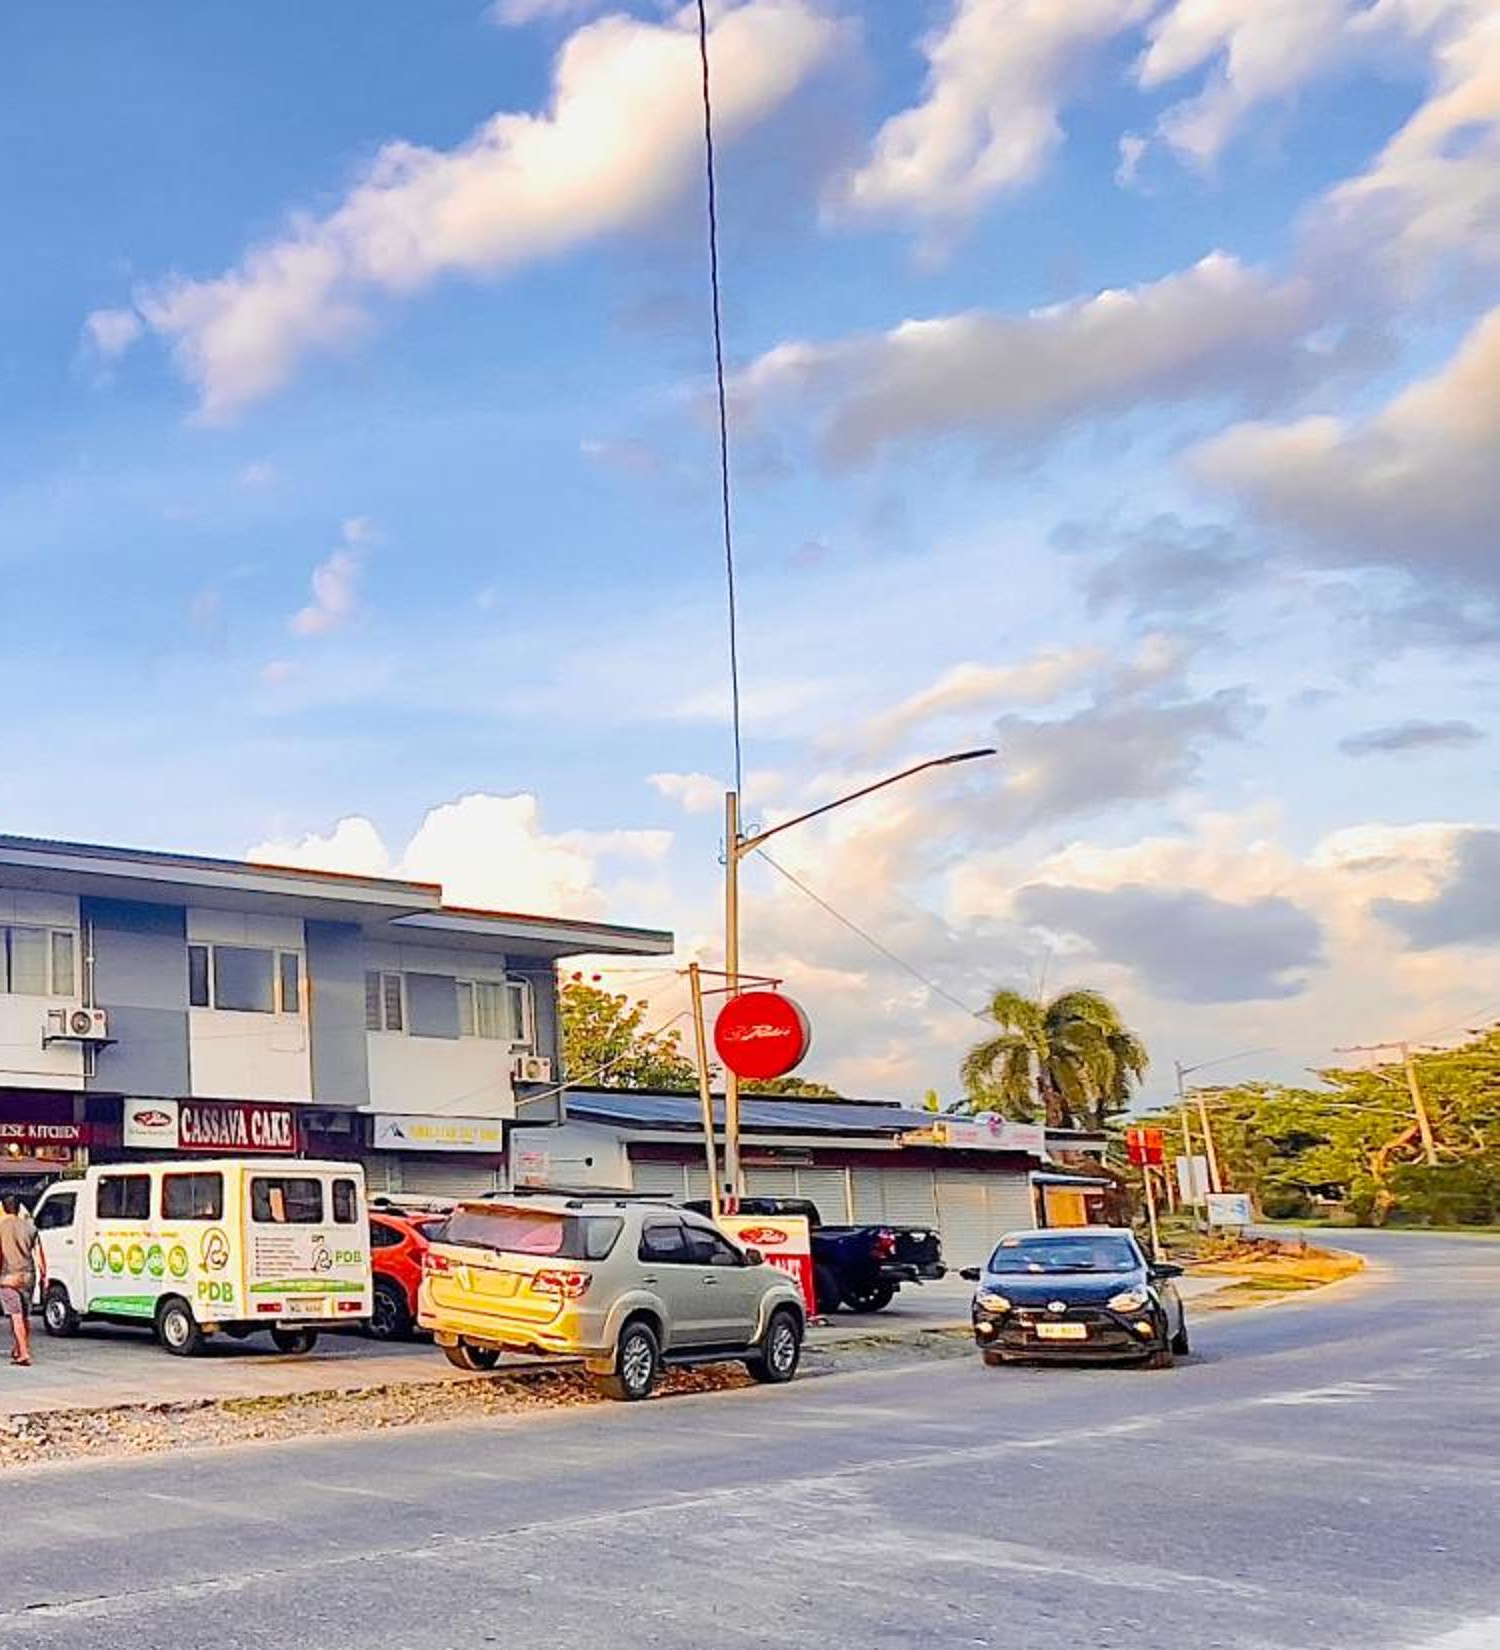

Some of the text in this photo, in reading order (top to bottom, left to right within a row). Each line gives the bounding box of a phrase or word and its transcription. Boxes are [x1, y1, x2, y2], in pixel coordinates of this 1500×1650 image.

[28, 1125, 80, 1138] KITCHEN
[181, 1108, 248, 1145] CASSAVA
[252, 1111, 293, 1146] CAKE
[197, 1281, 234, 1303] PDB
